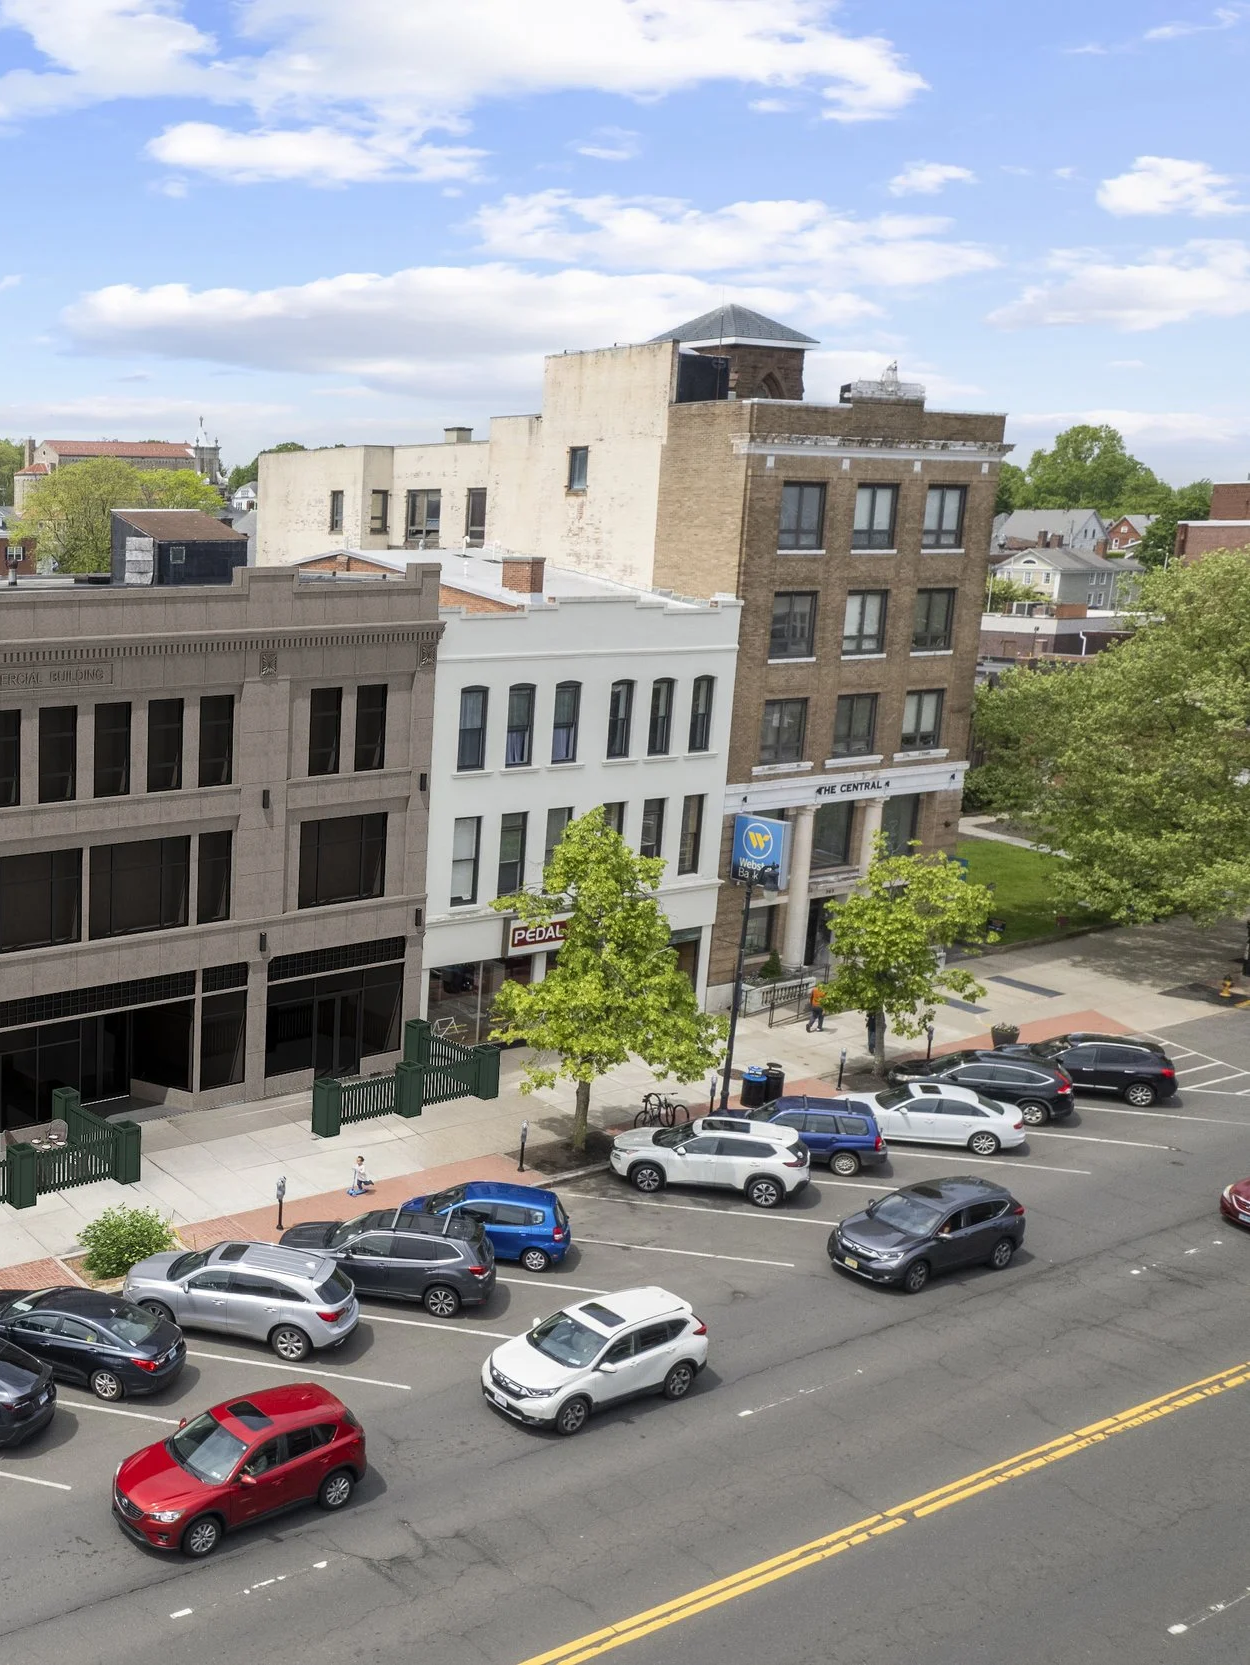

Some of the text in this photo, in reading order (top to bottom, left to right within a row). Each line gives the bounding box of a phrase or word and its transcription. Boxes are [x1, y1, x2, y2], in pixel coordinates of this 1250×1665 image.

[50, 668, 104, 683] BUILDING
[840, 781, 882, 793] CENTRAL
[739, 857, 770, 872] Webst
[738, 867, 758, 880] Bak
[514, 924, 564, 944] PEDAL
